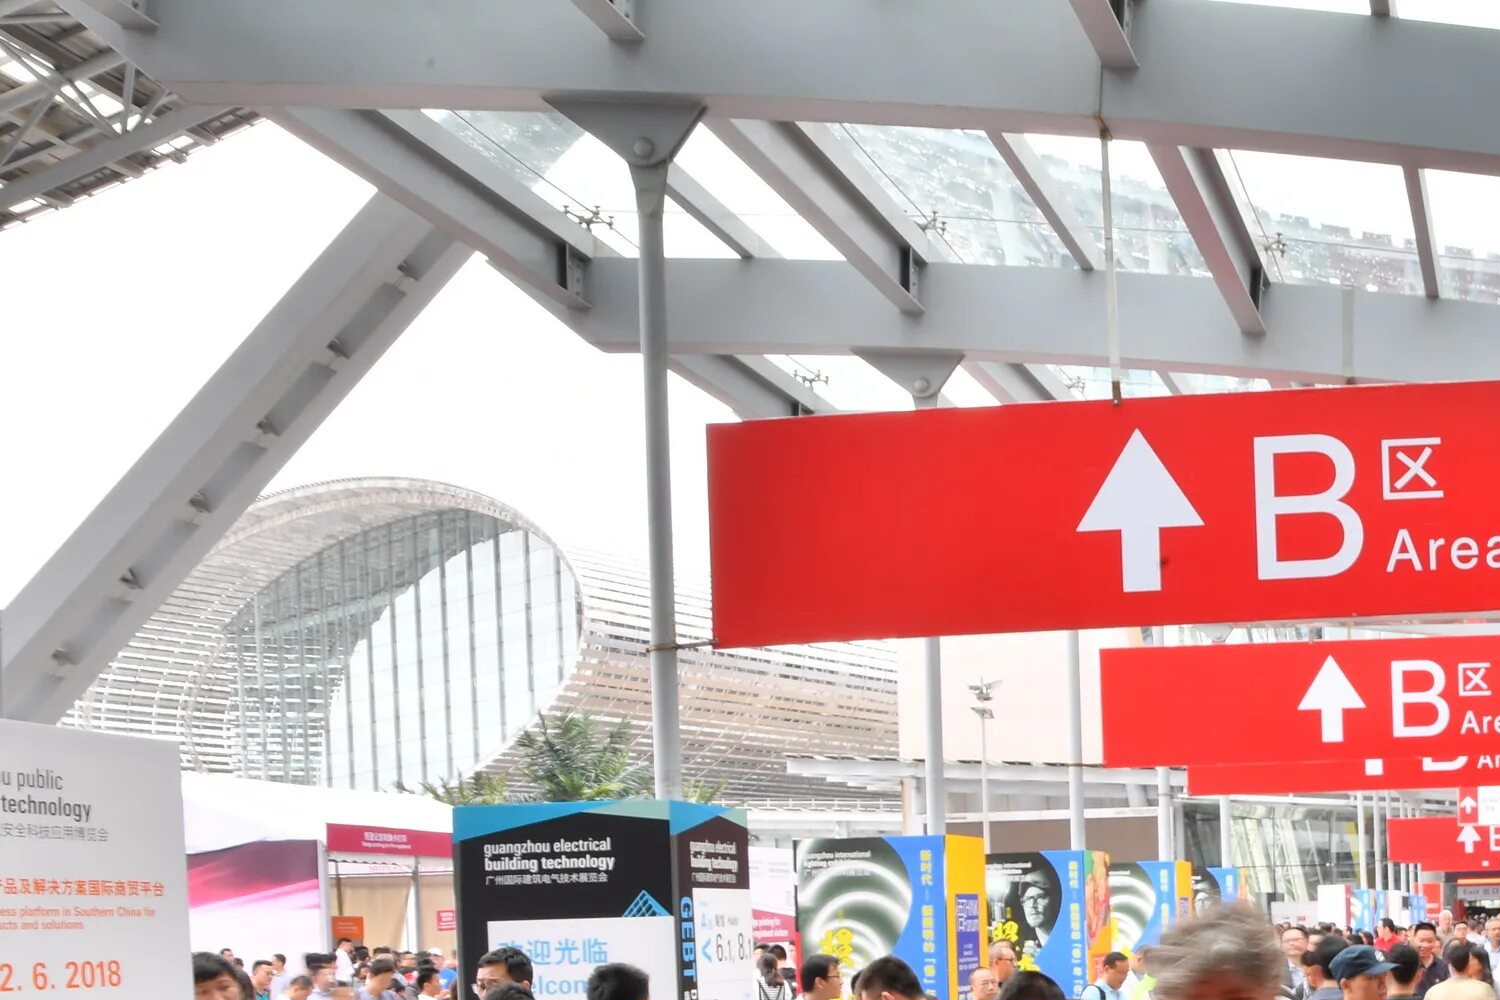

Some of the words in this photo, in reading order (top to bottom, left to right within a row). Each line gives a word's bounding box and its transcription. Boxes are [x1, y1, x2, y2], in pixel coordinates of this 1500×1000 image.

[1381, 437, 1444, 501] 区
[1253, 433, 1364, 581] B
[1458, 662, 1492, 697] 区
[1390, 659, 1450, 738] B
[17, 768, 64, 791] public
[1, 795, 92, 822] technology
[0, 823, 108, 842] 安全科技应用博览会
[484, 840, 551, 857] guangzhou
[553, 837, 611, 852] electrical
[484, 857, 538, 872] building
[541, 854, 615, 871] technology
[0, 877, 164, 897] 品及解决方案国际商贸平台
[680, 896, 697, 983] GEBT
[65, 960, 121, 989] 2018
